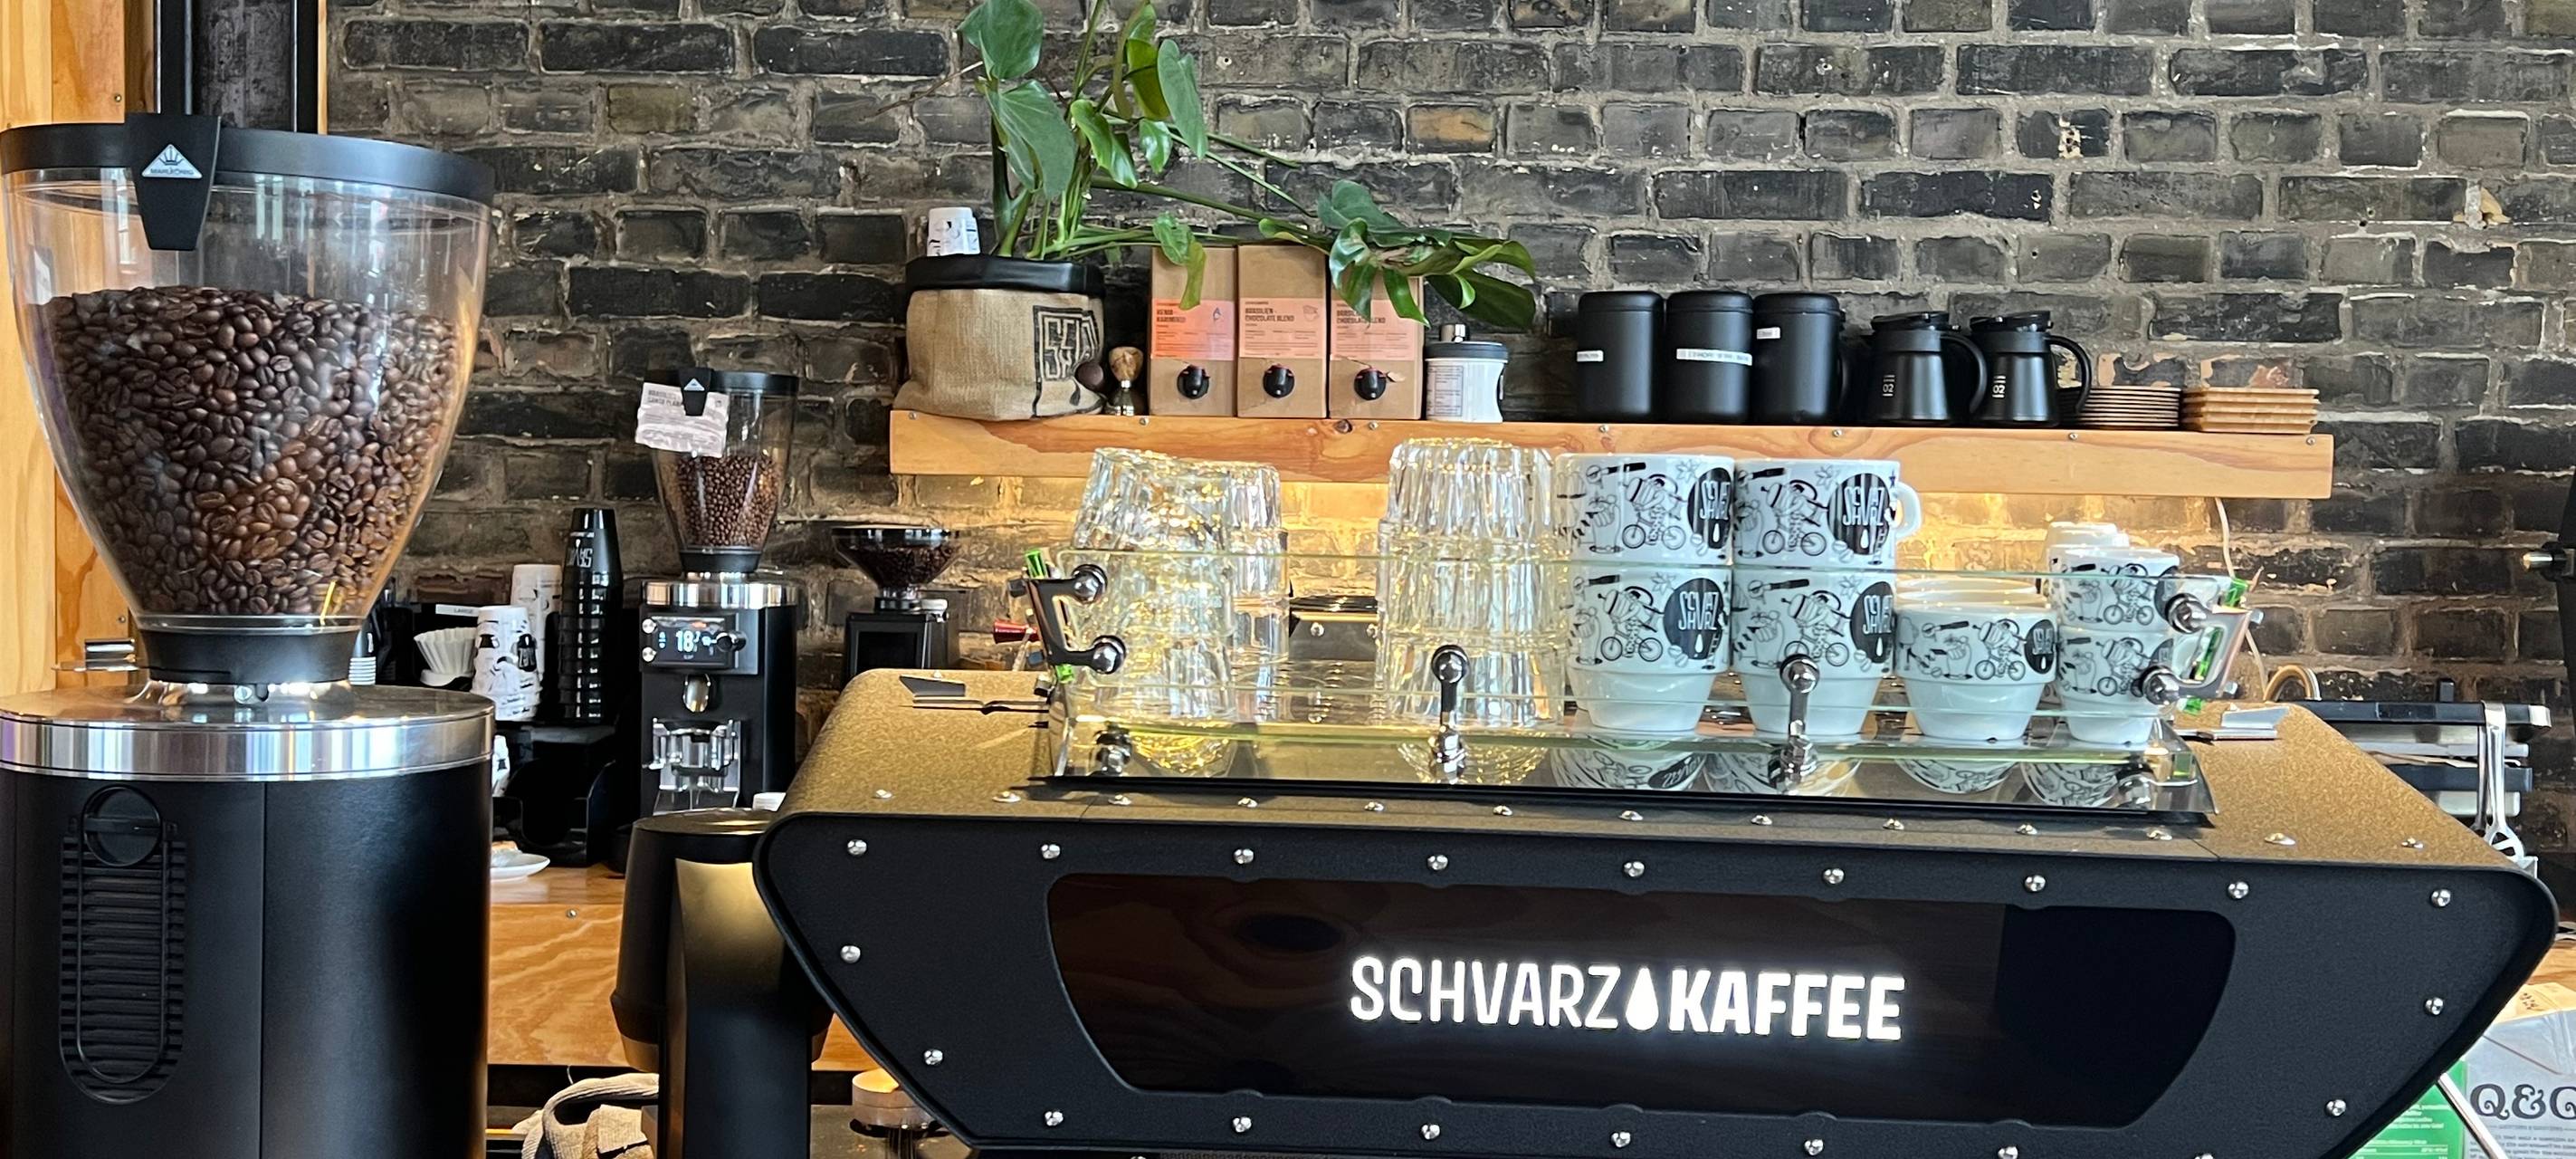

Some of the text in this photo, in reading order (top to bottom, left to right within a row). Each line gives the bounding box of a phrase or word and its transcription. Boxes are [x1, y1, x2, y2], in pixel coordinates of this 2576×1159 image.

[1883, 383, 1894, 393] 02
[1992, 384, 2006, 394] 02
[1350, 955, 1905, 1041] SCHVARZ KAFFEE
